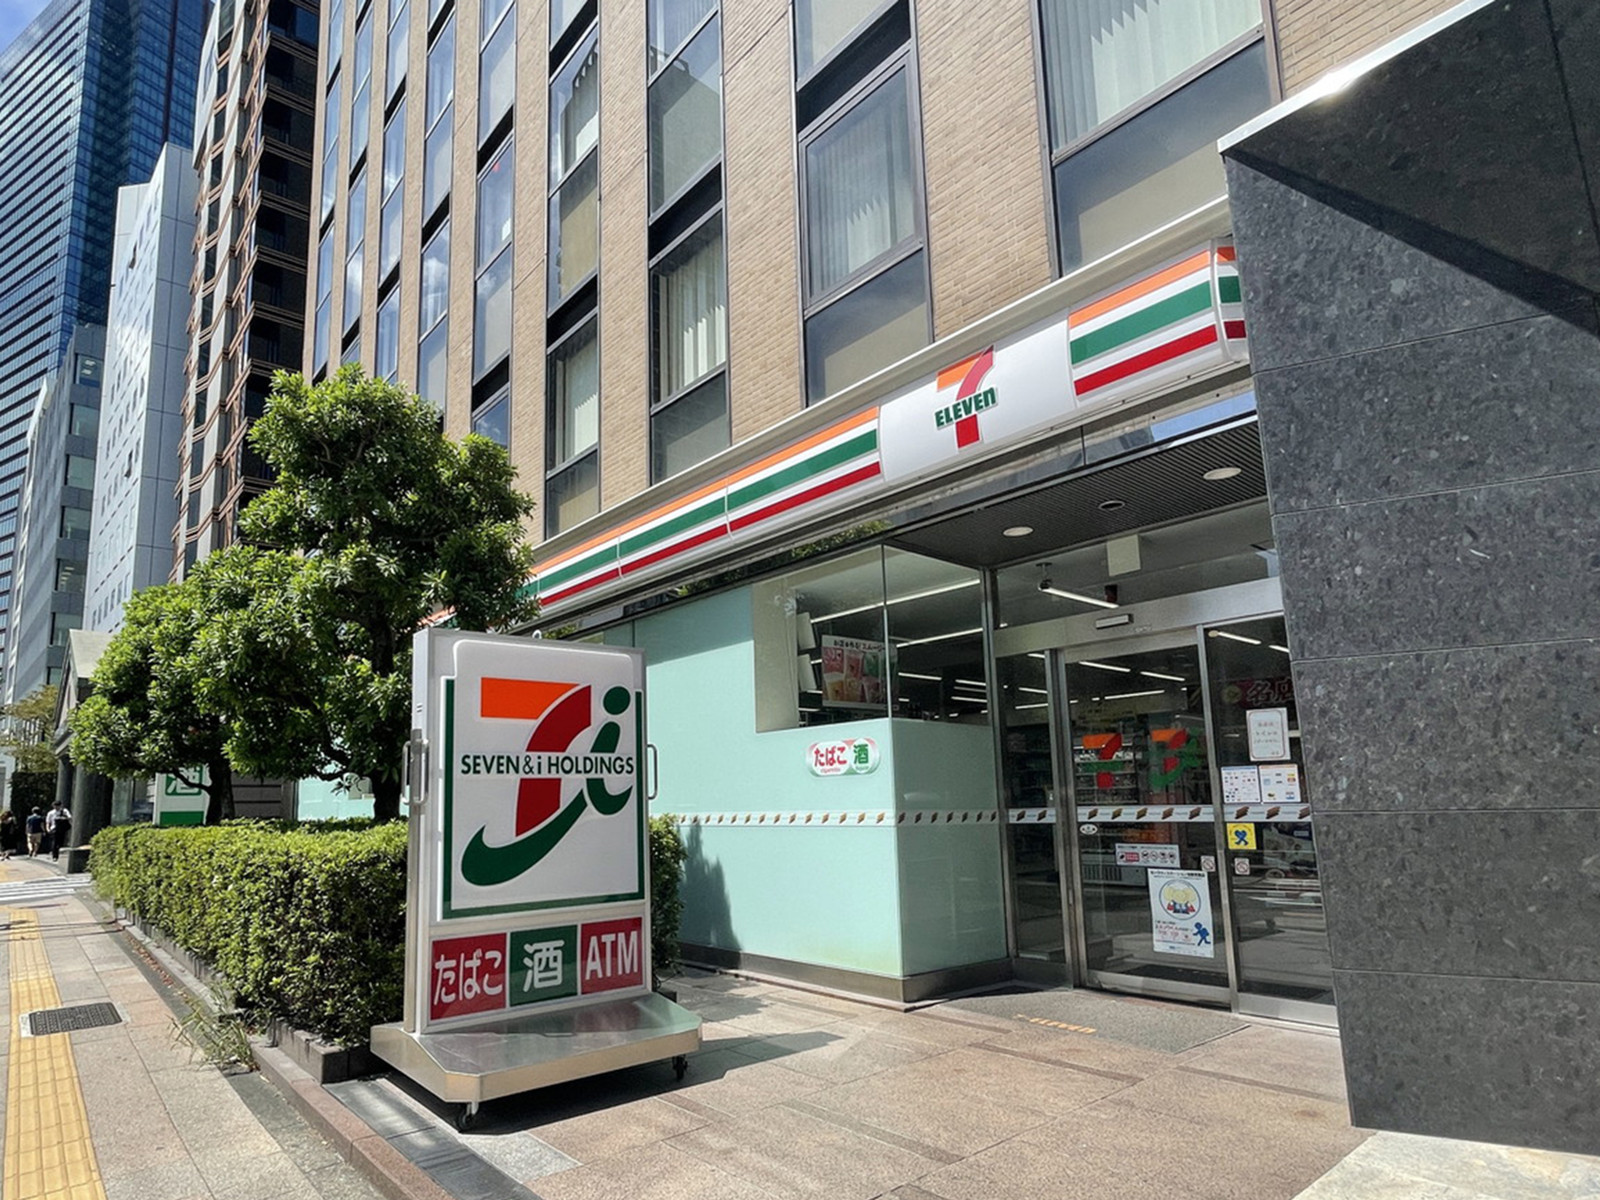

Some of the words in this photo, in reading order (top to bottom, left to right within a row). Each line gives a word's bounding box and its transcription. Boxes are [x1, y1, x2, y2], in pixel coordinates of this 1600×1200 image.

[548, 755, 634, 775] HOLDINGS
[814, 746, 848, 767] たばこ
[853, 744, 869, 764] 酒
[434, 948, 504, 1006] たばこ
[523, 939, 565, 993] 酒
[585, 930, 639, 981] ATM
